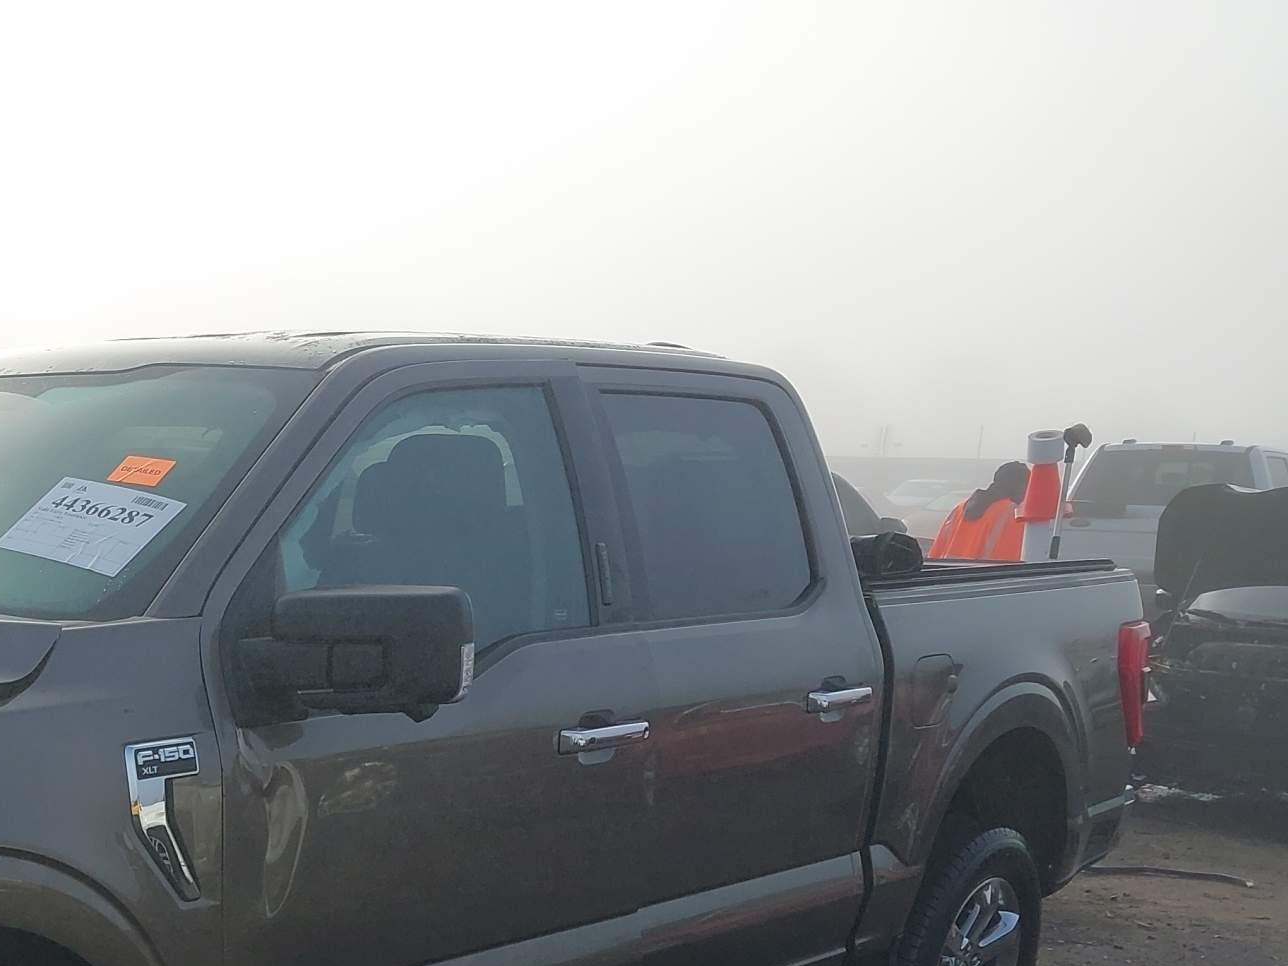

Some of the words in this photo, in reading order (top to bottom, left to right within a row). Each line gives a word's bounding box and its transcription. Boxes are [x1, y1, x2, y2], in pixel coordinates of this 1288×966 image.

[52, 495, 154, 527] 44366287
[137, 744, 194, 765] F-150
[142, 766, 158, 775] XLT
